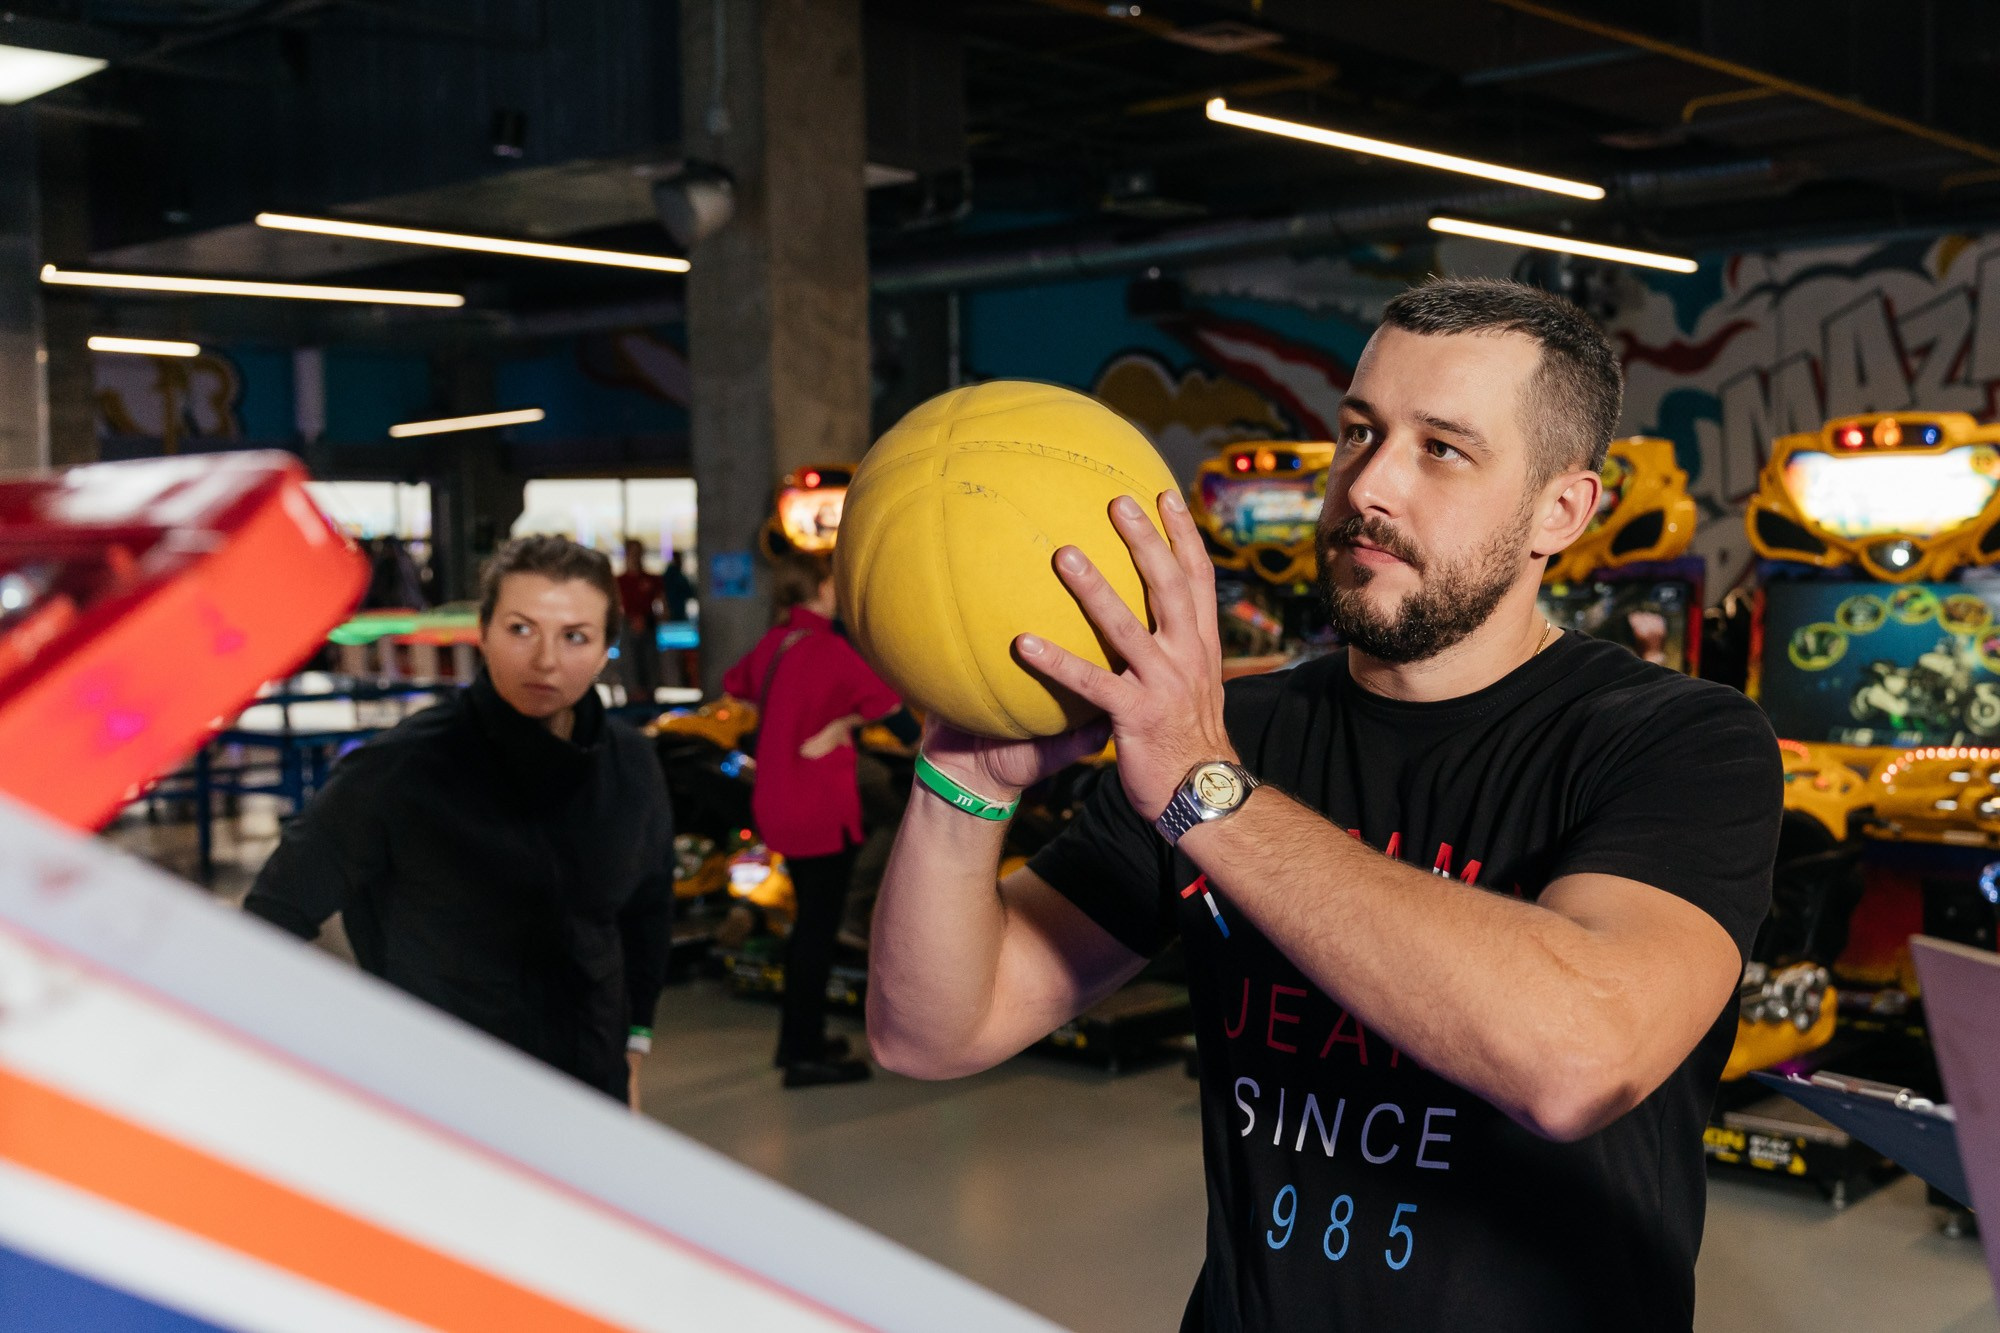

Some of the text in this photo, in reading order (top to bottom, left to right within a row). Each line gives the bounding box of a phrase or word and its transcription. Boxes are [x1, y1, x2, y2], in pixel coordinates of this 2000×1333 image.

[1223, 977, 1426, 1070] JEA
[1234, 1076, 1457, 1170] SINCE
[1250, 1183, 1418, 1270] 985
